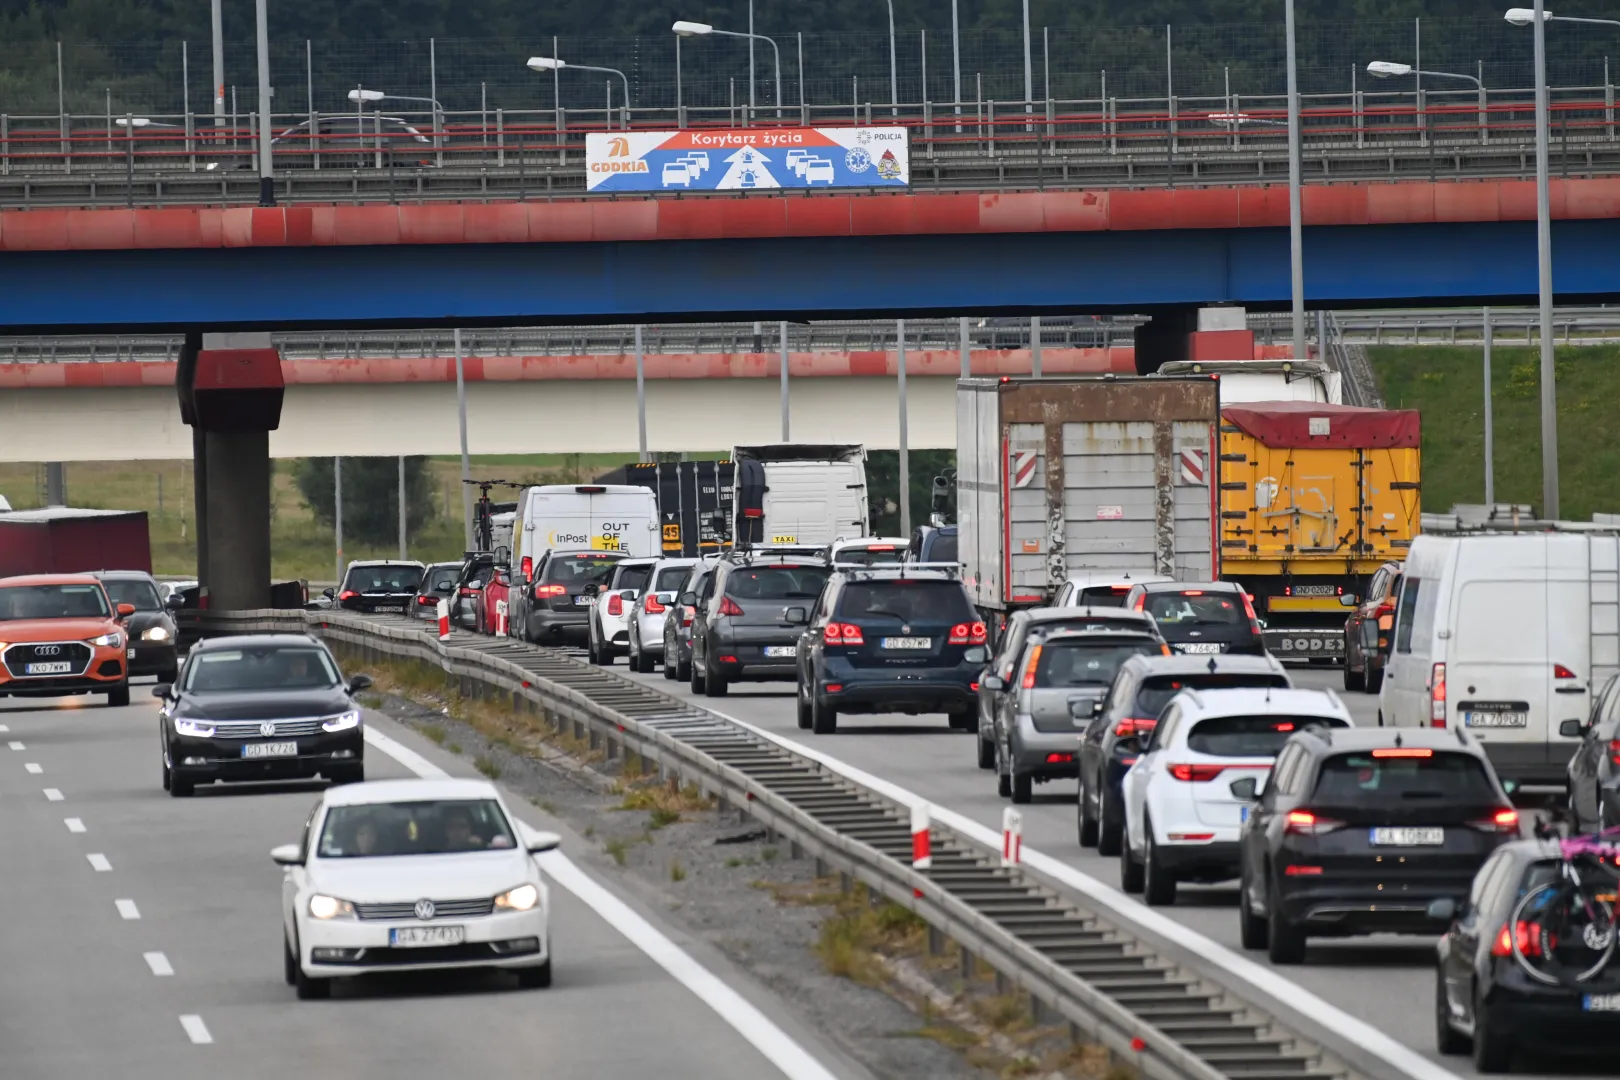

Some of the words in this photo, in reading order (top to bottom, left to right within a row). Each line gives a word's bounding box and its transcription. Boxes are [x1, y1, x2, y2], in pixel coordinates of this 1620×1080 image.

[692, 133, 757, 147] Korytarz
[763, 131, 803, 146] życia
[874, 133, 902, 141] POLICJA
[591, 161, 647, 172] GDDKiA
[602, 522, 630, 531] OUT
[602, 532, 620, 541] OF
[664, 527, 678, 538] 45
[556, 533, 588, 543] InPost
[602, 542, 628, 551] THE
